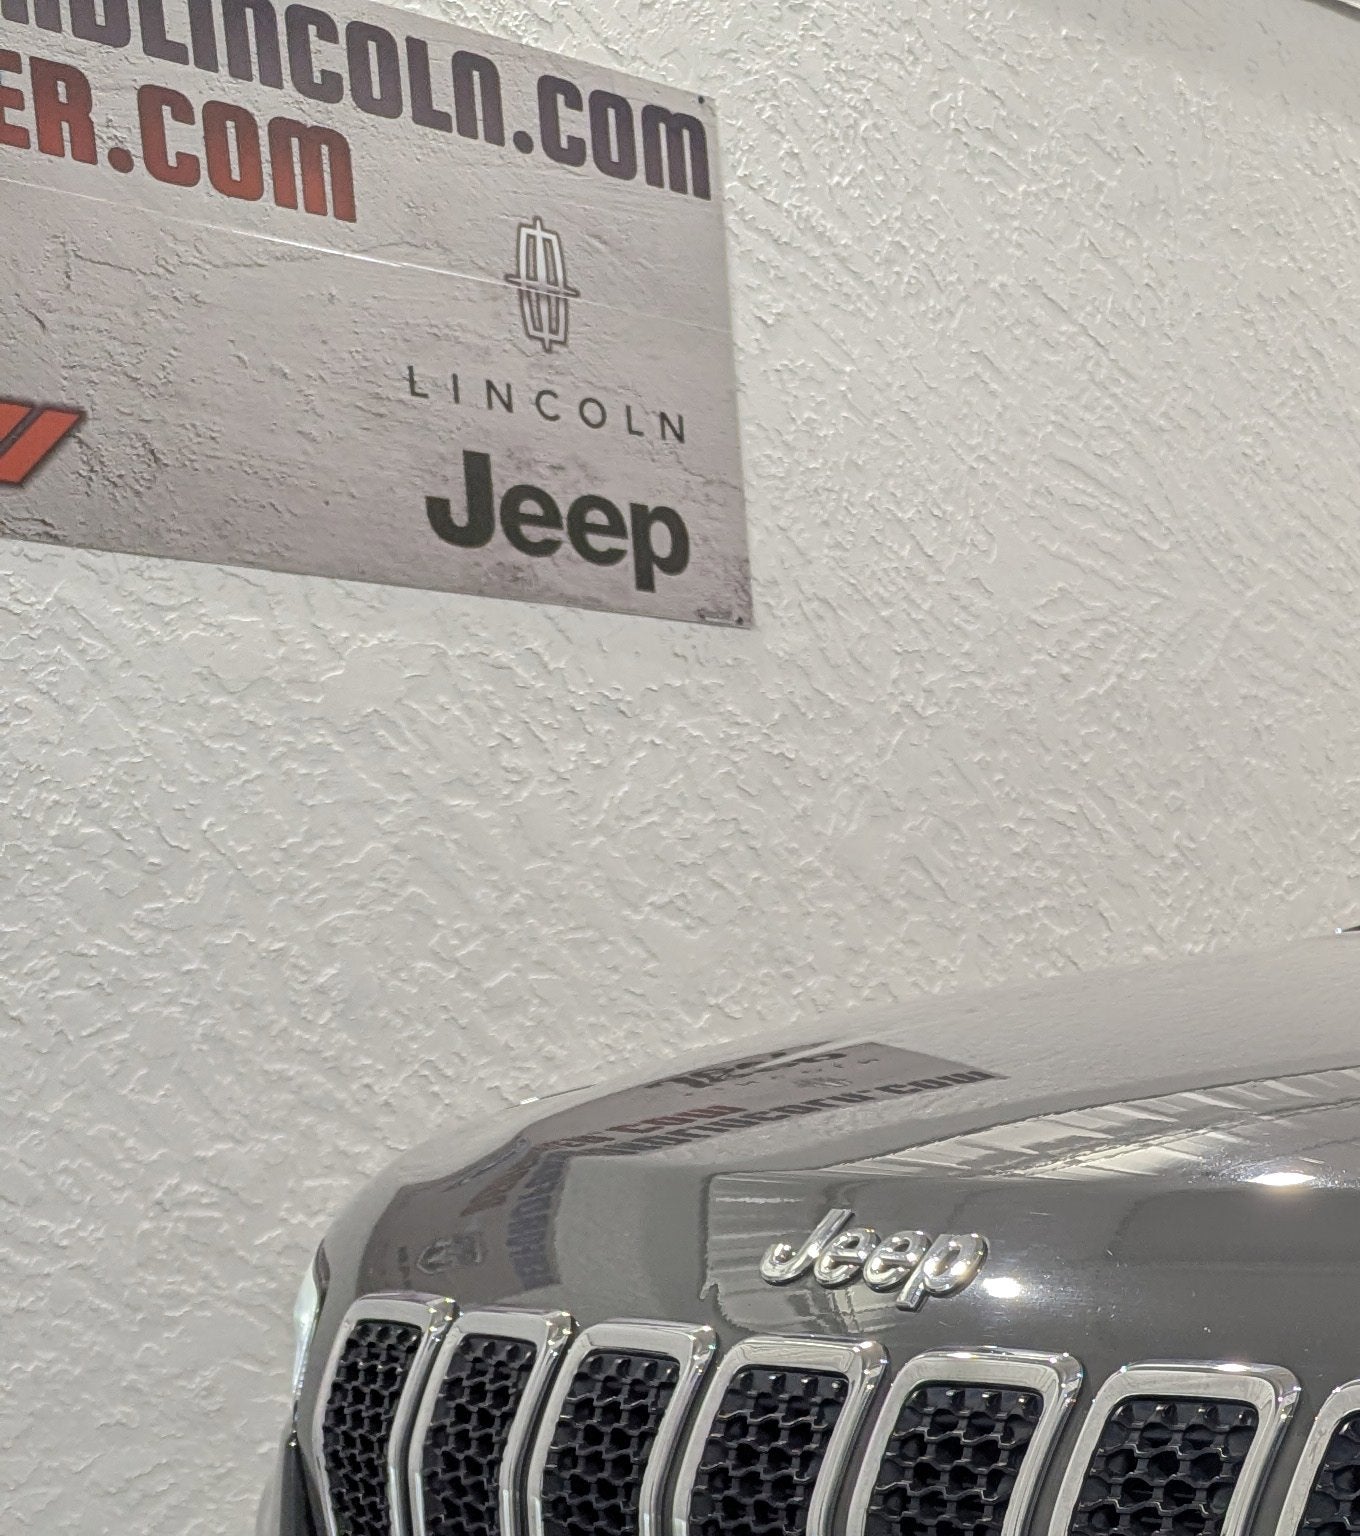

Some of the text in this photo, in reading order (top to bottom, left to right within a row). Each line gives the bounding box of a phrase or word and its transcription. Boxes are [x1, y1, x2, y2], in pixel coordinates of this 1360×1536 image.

[405, 365, 686, 444] LINCOLN
[425, 450, 690, 592] Jeep
[759, 1208, 988, 1312] Jeep
